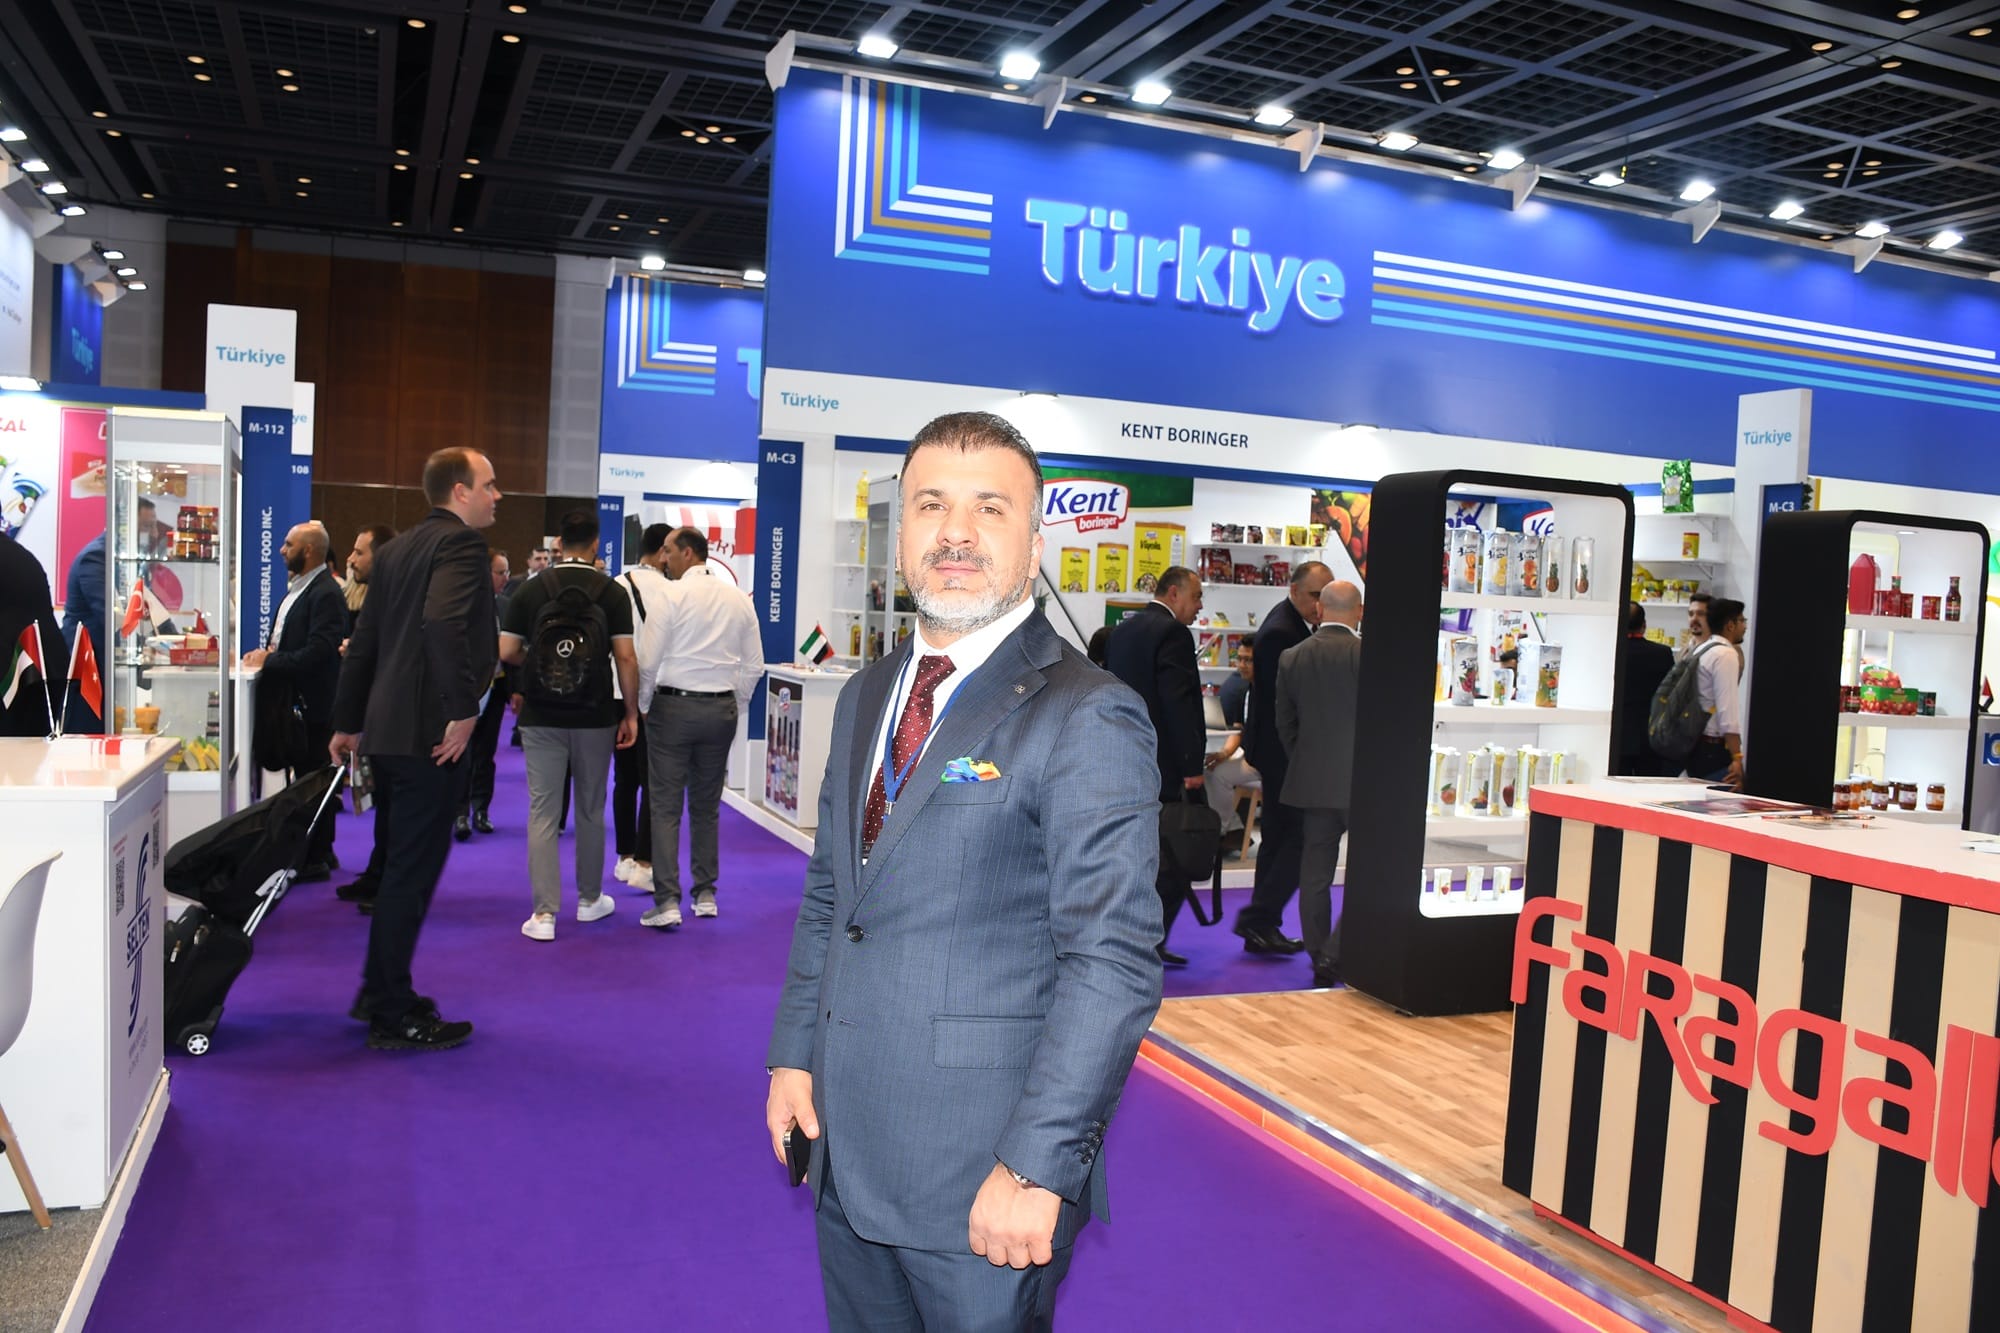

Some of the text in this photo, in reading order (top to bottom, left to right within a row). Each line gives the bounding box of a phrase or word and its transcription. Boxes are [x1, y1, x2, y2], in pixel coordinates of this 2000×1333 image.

[1025, 199, 1346, 332] Türkiye
[216, 346, 286, 367] Türkiye
[781, 391, 840, 411] Türkiye
[248, 422, 285, 435] M-112
[1121, 422, 1249, 449] KENT BORINGER
[1743, 429, 1792, 446] Türkiye
[766, 452, 796, 465] M-C3
[609, 467, 645, 478] Türkiye
[1045, 487, 1120, 515] Kent
[1769, 501, 1795, 513] M-C3
[261, 506, 273, 529] INC.
[1079, 516, 1117, 530] boringer
[261, 530, 272, 562] FOOD
[769, 527, 784, 622] KENT BORINGER
[260, 564, 272, 615] GENERAL
